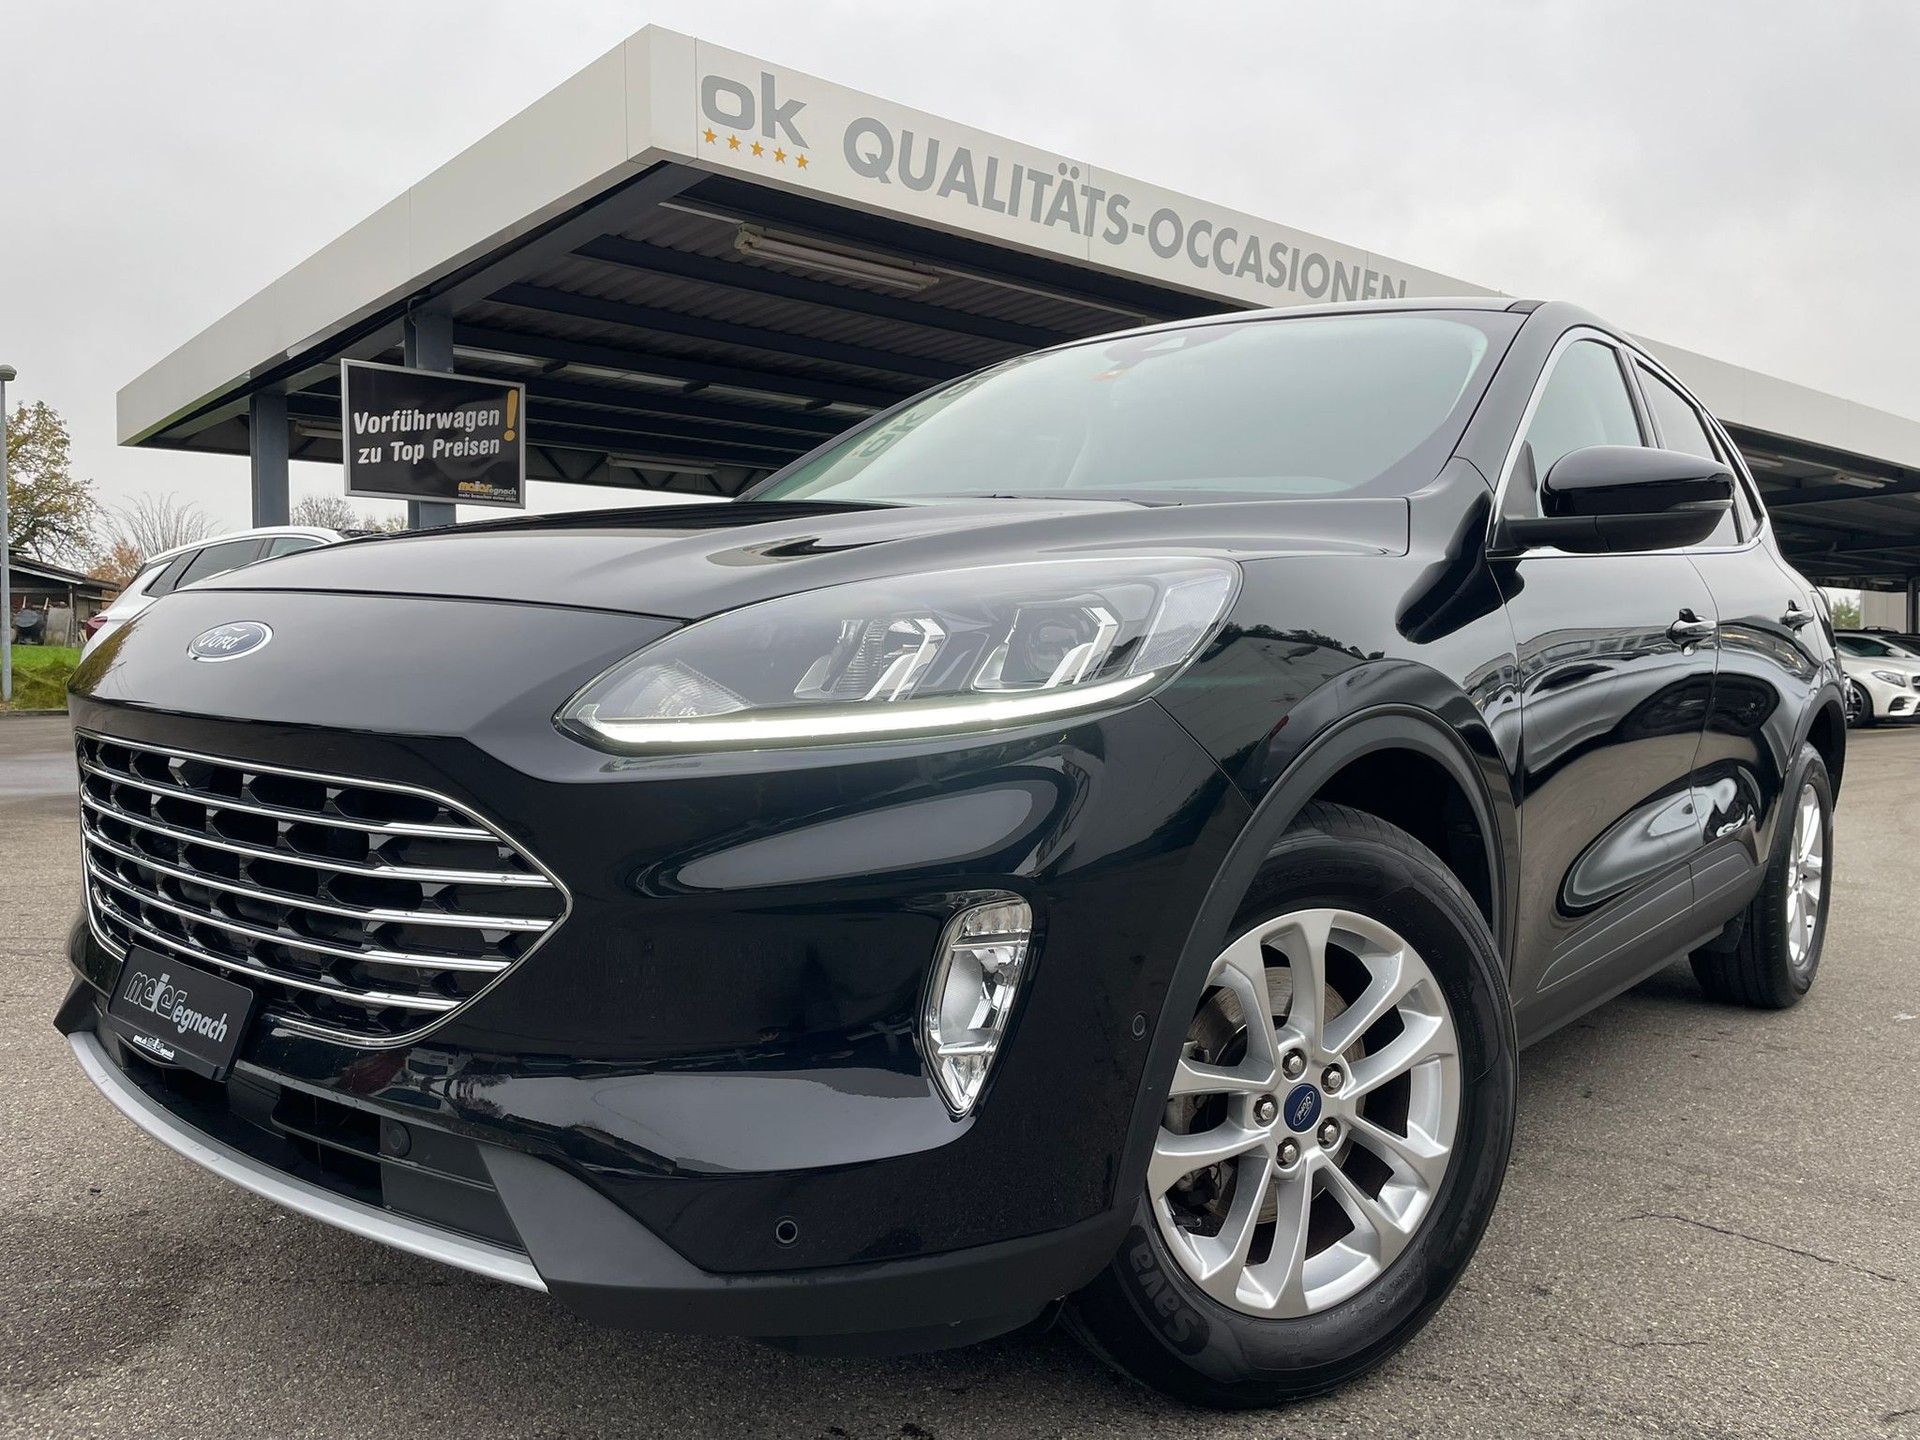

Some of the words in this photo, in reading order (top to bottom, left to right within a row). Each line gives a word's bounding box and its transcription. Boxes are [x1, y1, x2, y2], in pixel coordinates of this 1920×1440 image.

[700, 71, 810, 150] ok
[353, 408, 500, 435] Vorführwagen
[357, 446, 382, 464] zu
[389, 440, 425, 465] Top
[431, 436, 500, 459] Preisen
[198, 626, 250, 650] Ford
[1129, 1241, 1201, 1342] Sava
